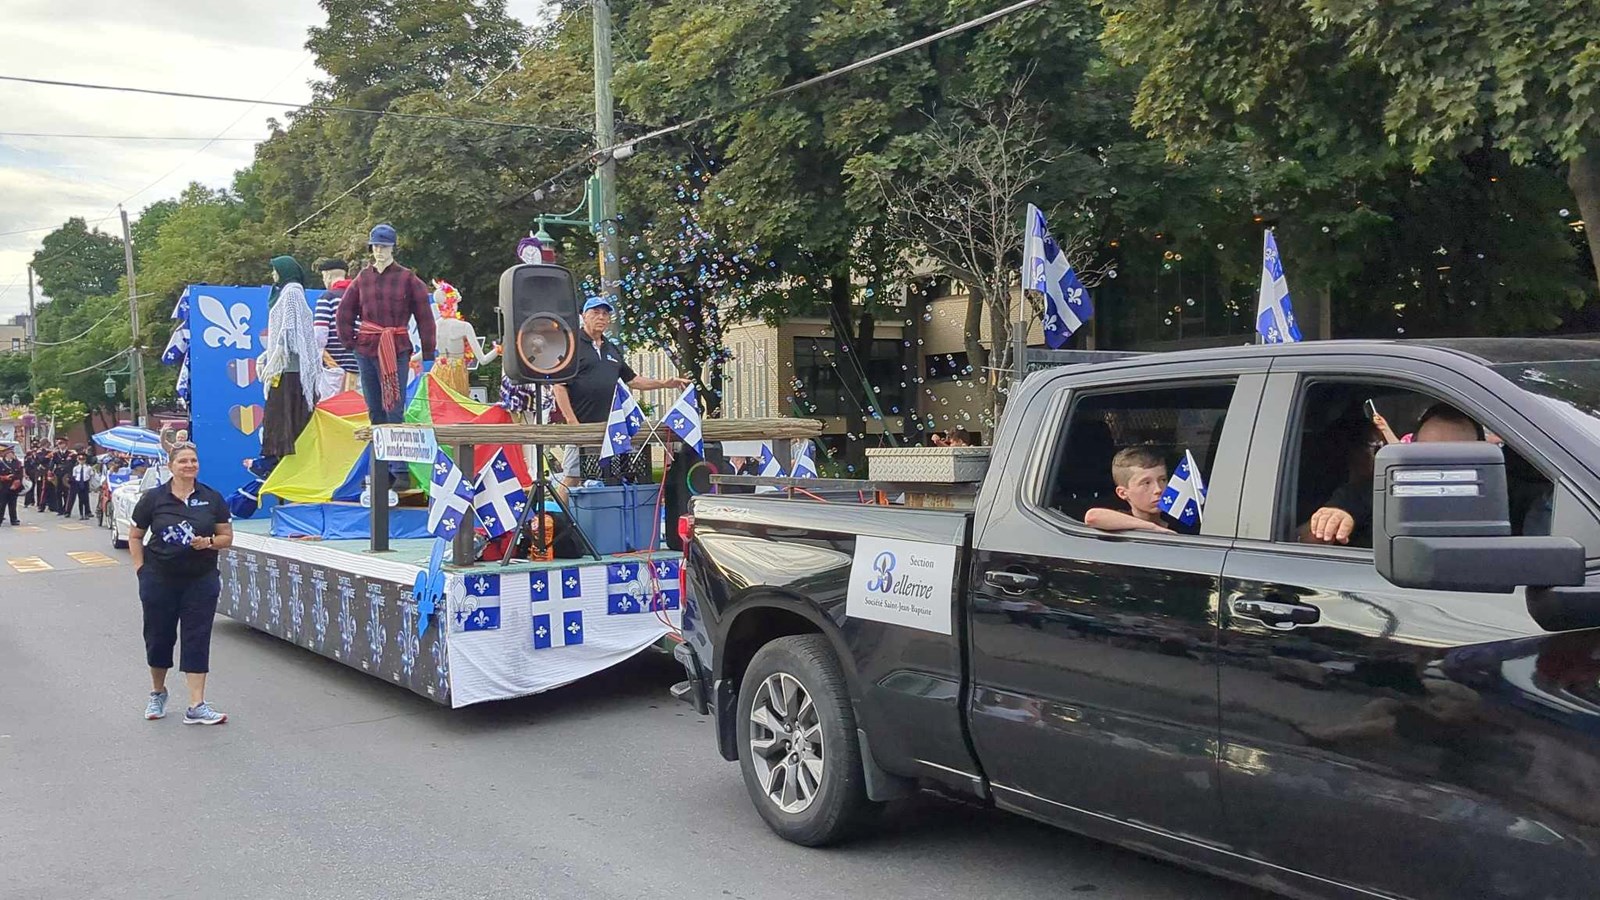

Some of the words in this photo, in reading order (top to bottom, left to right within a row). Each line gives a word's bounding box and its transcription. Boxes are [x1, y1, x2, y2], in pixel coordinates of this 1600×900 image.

[910, 555, 934, 569] Section
[867, 551, 934, 600] Bellerive
[864, 597, 884, 608] Société
